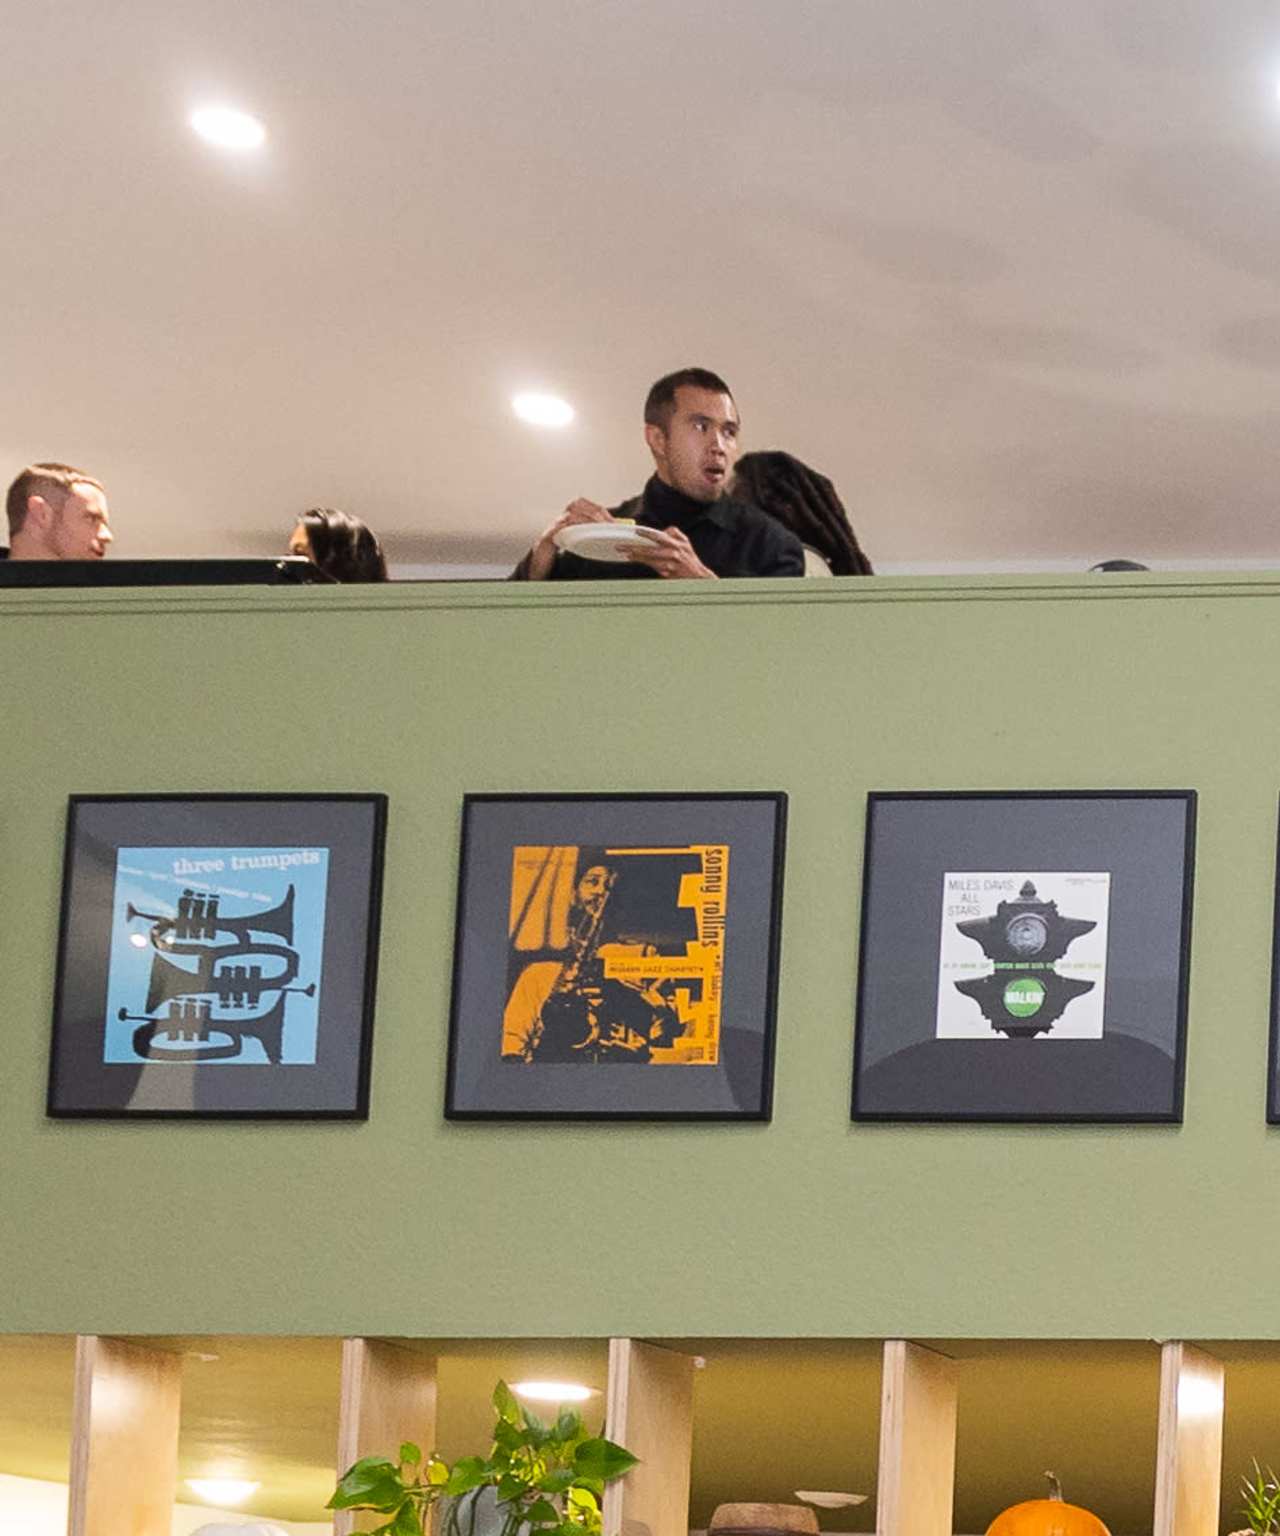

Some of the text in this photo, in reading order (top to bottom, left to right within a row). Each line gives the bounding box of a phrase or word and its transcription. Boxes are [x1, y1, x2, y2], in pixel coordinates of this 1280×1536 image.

[174, 858, 225, 875] three
[231, 850, 320, 871] trumpets
[948, 880, 1015, 891] MILES DAVIS
[701, 848, 726, 948] sonny rollins
[961, 894, 979, 904] ALL
[947, 905, 981, 916] STARS
